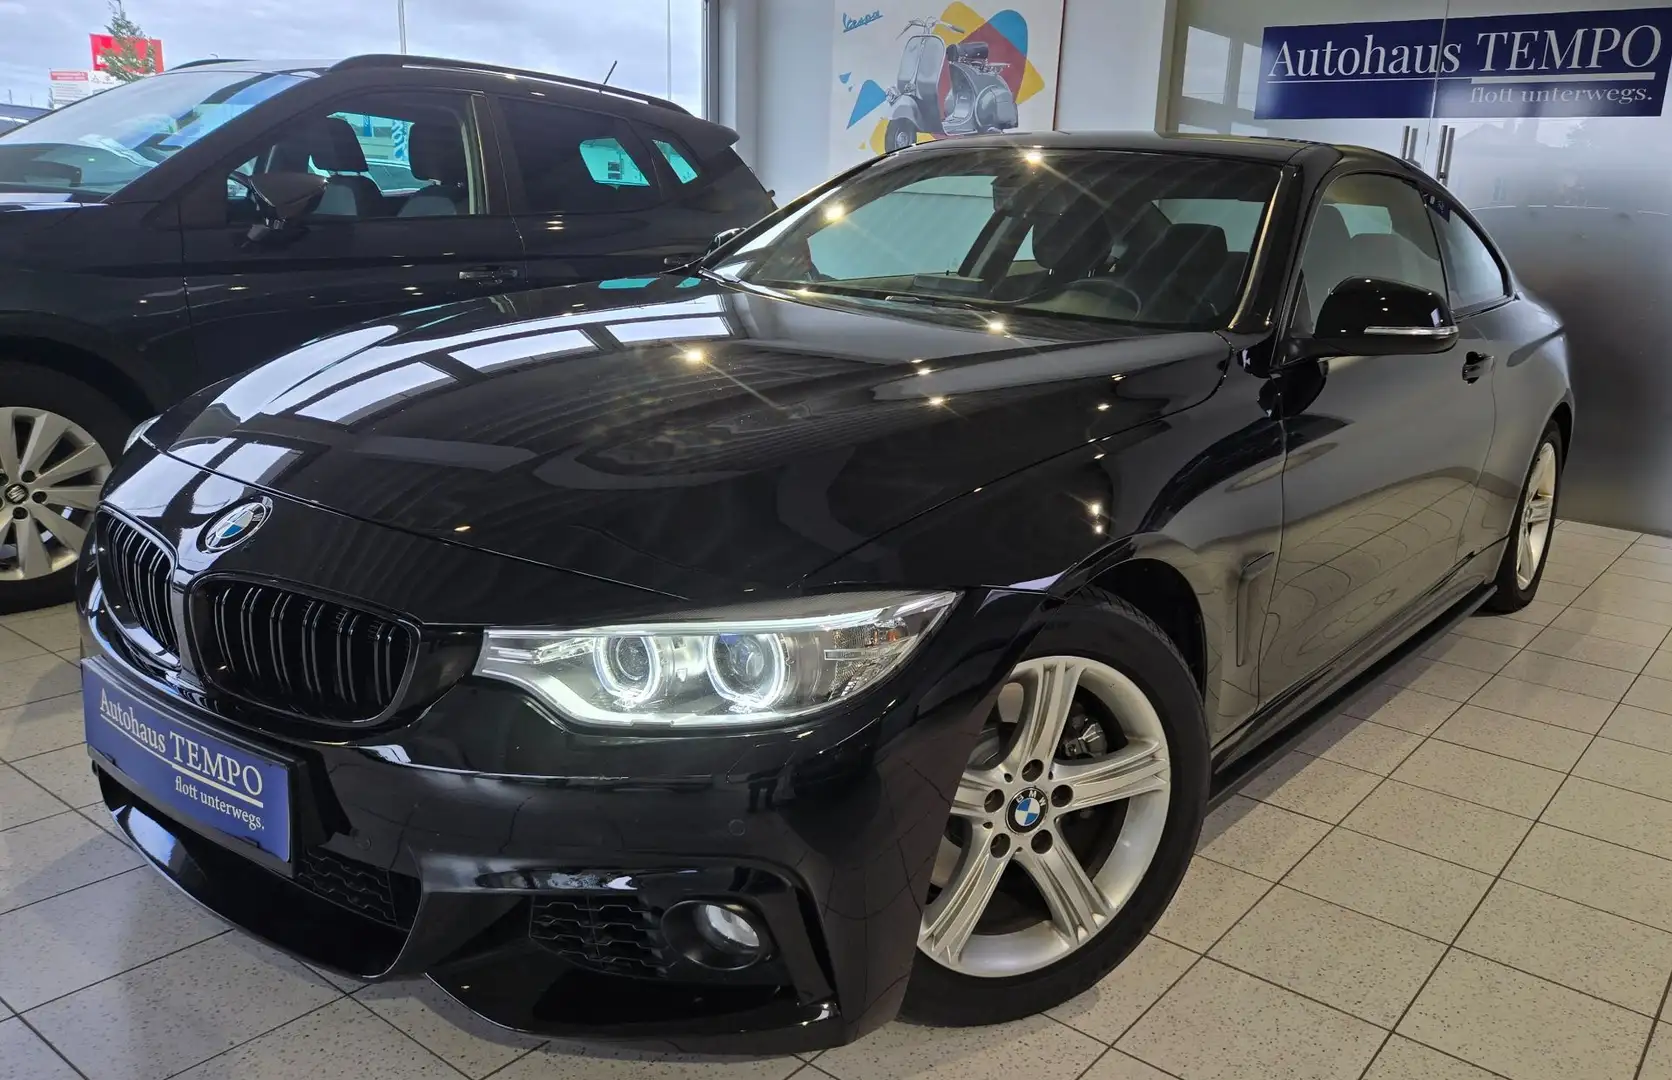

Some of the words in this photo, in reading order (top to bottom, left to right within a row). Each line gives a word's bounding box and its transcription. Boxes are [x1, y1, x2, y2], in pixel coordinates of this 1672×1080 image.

[842, 10, 884, 33] Vespa
[1267, 34, 1463, 77] Autohaus
[1476, 24, 1663, 71] TEMPO
[1470, 87, 1514, 104] flott
[1521, 87, 1654, 105] unterwegs.
[100, 688, 166, 753] Autohaus
[169, 731, 264, 796] TEMPO
[175, 775, 199, 801] flott
[200, 791, 265, 830] unterwegs.
